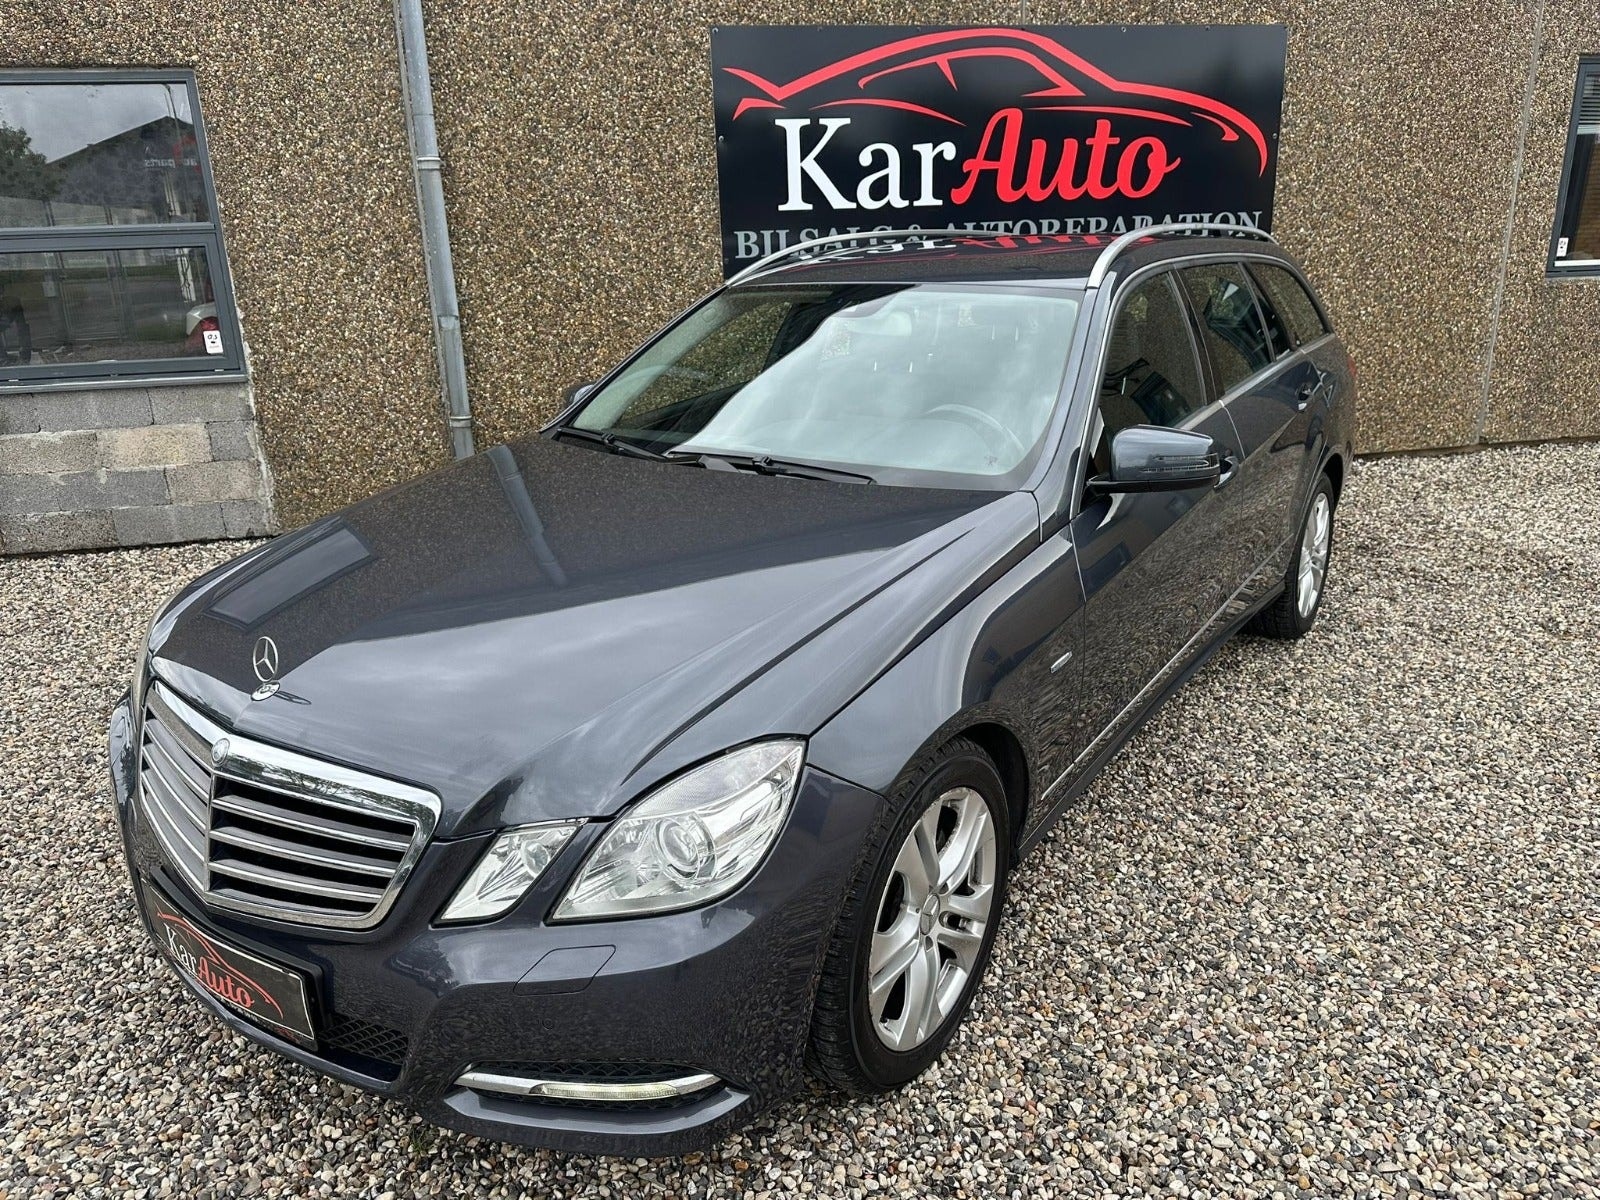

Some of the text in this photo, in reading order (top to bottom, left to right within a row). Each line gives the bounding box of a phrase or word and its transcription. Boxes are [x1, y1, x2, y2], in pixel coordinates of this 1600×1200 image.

[775, 108, 1181, 212] KarAuto
[946, 211, 1262, 239] TOREPARTION
[163, 922, 255, 1008] KarAuto
